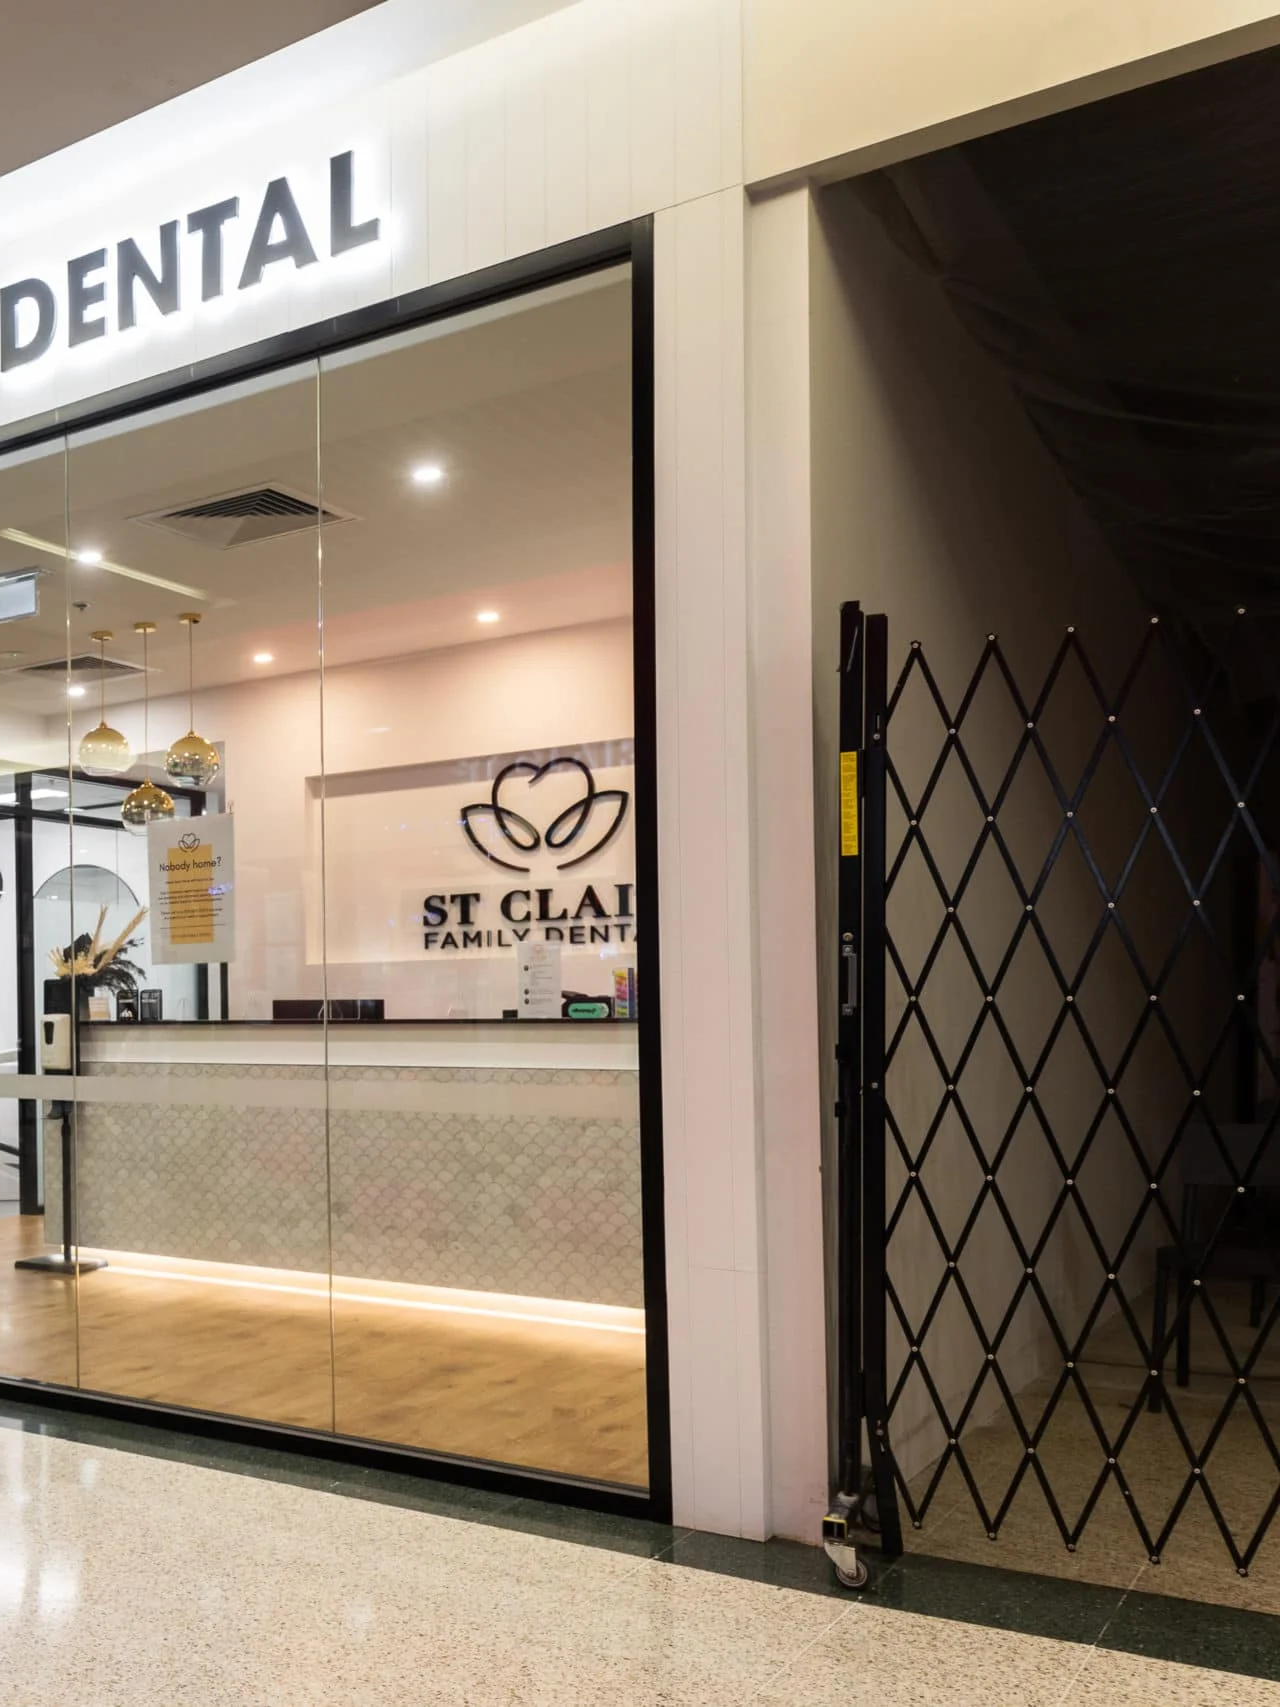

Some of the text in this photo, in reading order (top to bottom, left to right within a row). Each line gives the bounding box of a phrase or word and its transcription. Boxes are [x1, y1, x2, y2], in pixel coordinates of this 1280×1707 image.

[0, 150, 380, 373] DENTAL
[159, 856, 222, 872] Nobody home?
[423, 883, 634, 927] ST CLAI
[424, 923, 637, 950] FAMILY DENT
